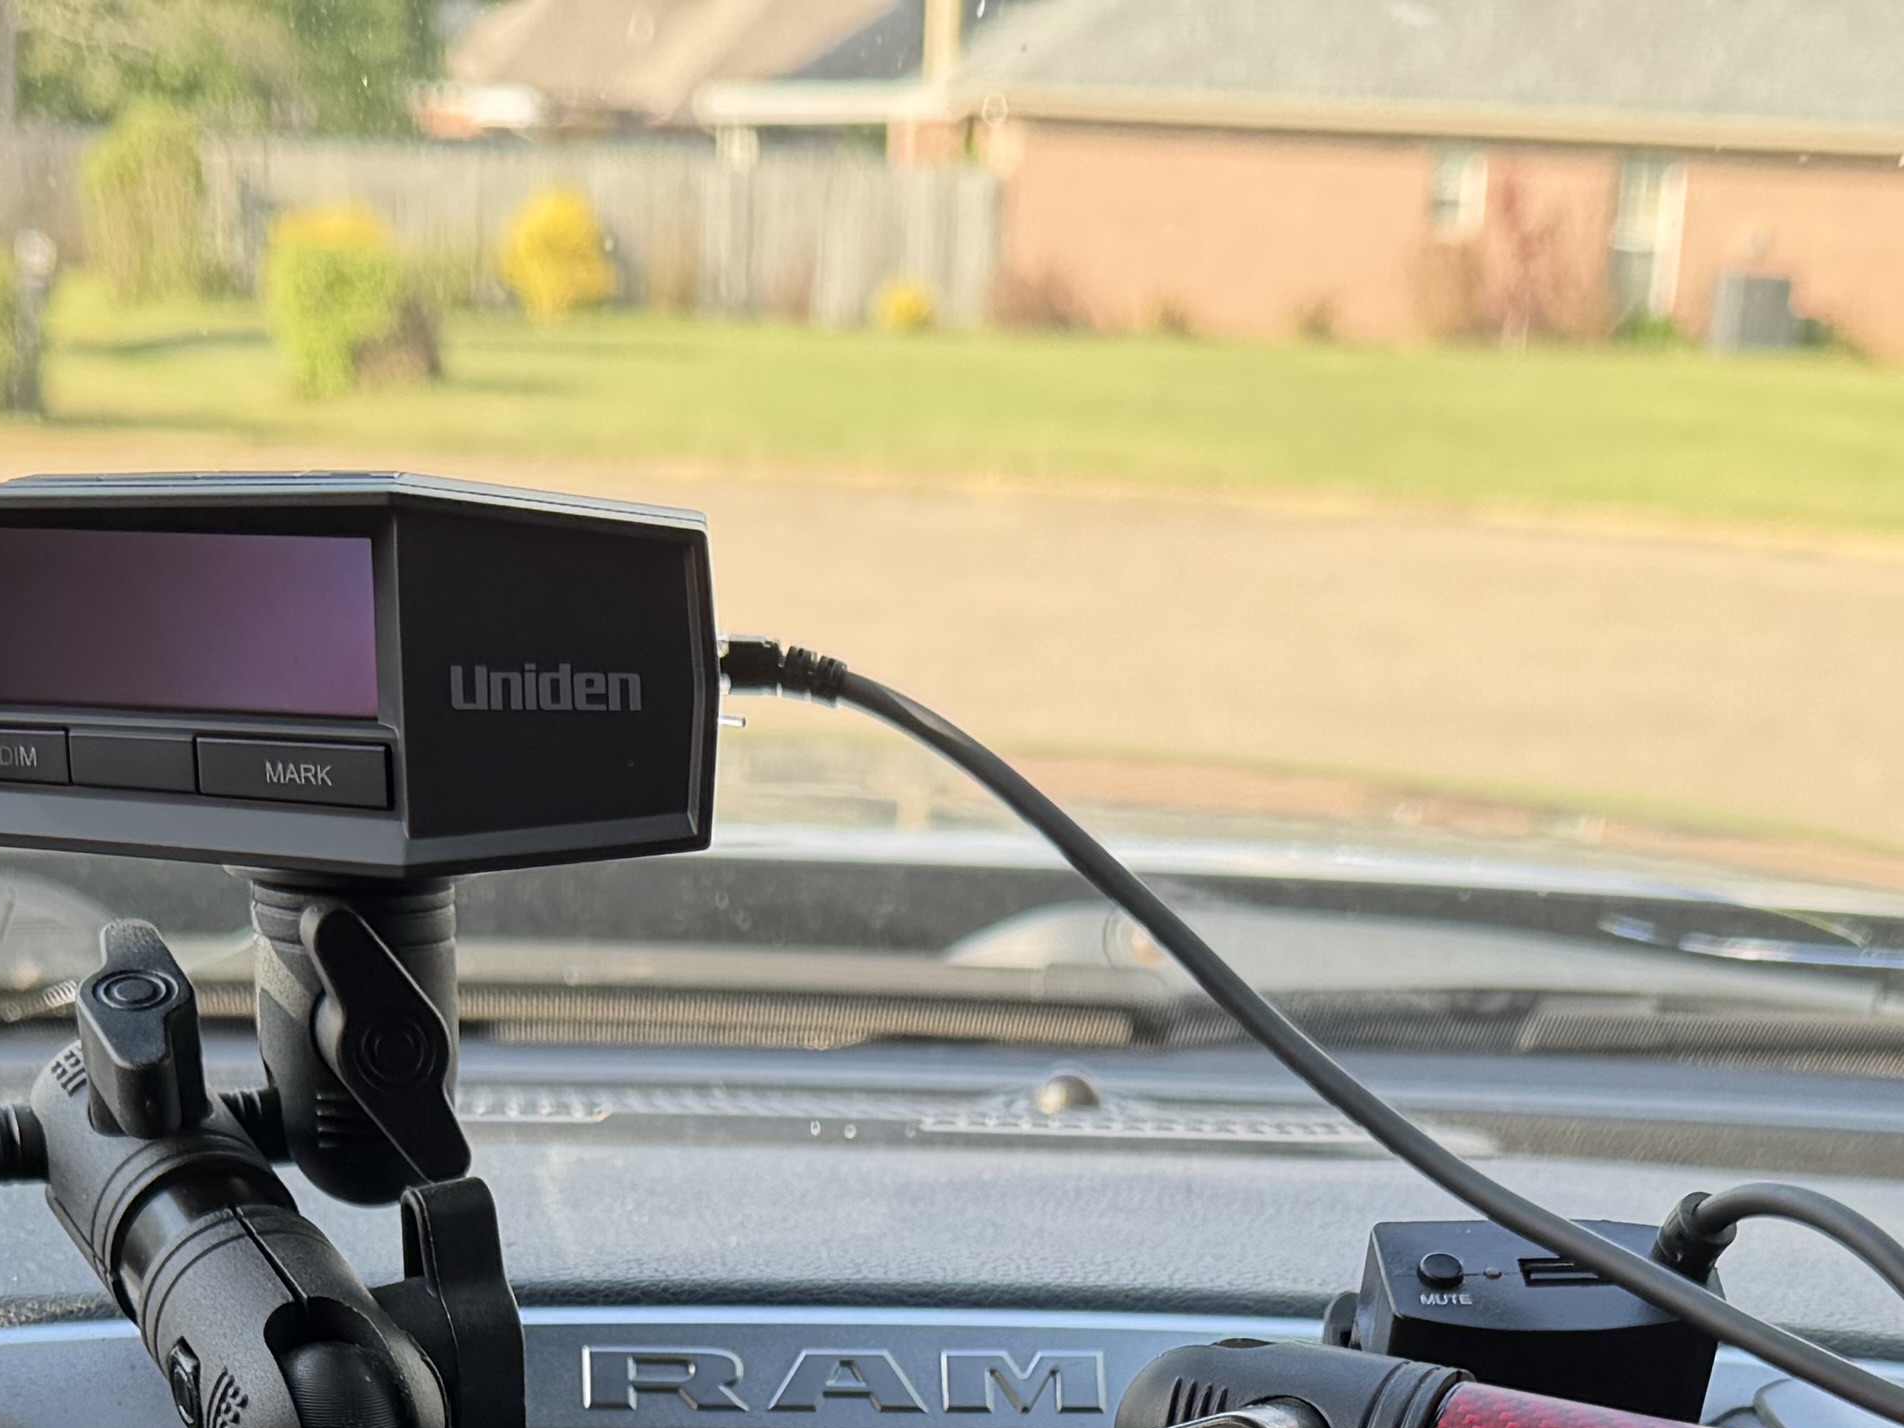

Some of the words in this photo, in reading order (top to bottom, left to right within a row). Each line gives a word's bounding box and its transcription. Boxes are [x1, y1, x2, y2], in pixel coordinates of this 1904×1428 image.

[451, 662, 644, 712] Uniden
[265, 760, 332, 787] MARK
[1420, 1294, 1472, 1306] MUTE
[581, 1344, 1107, 1415] RAM
